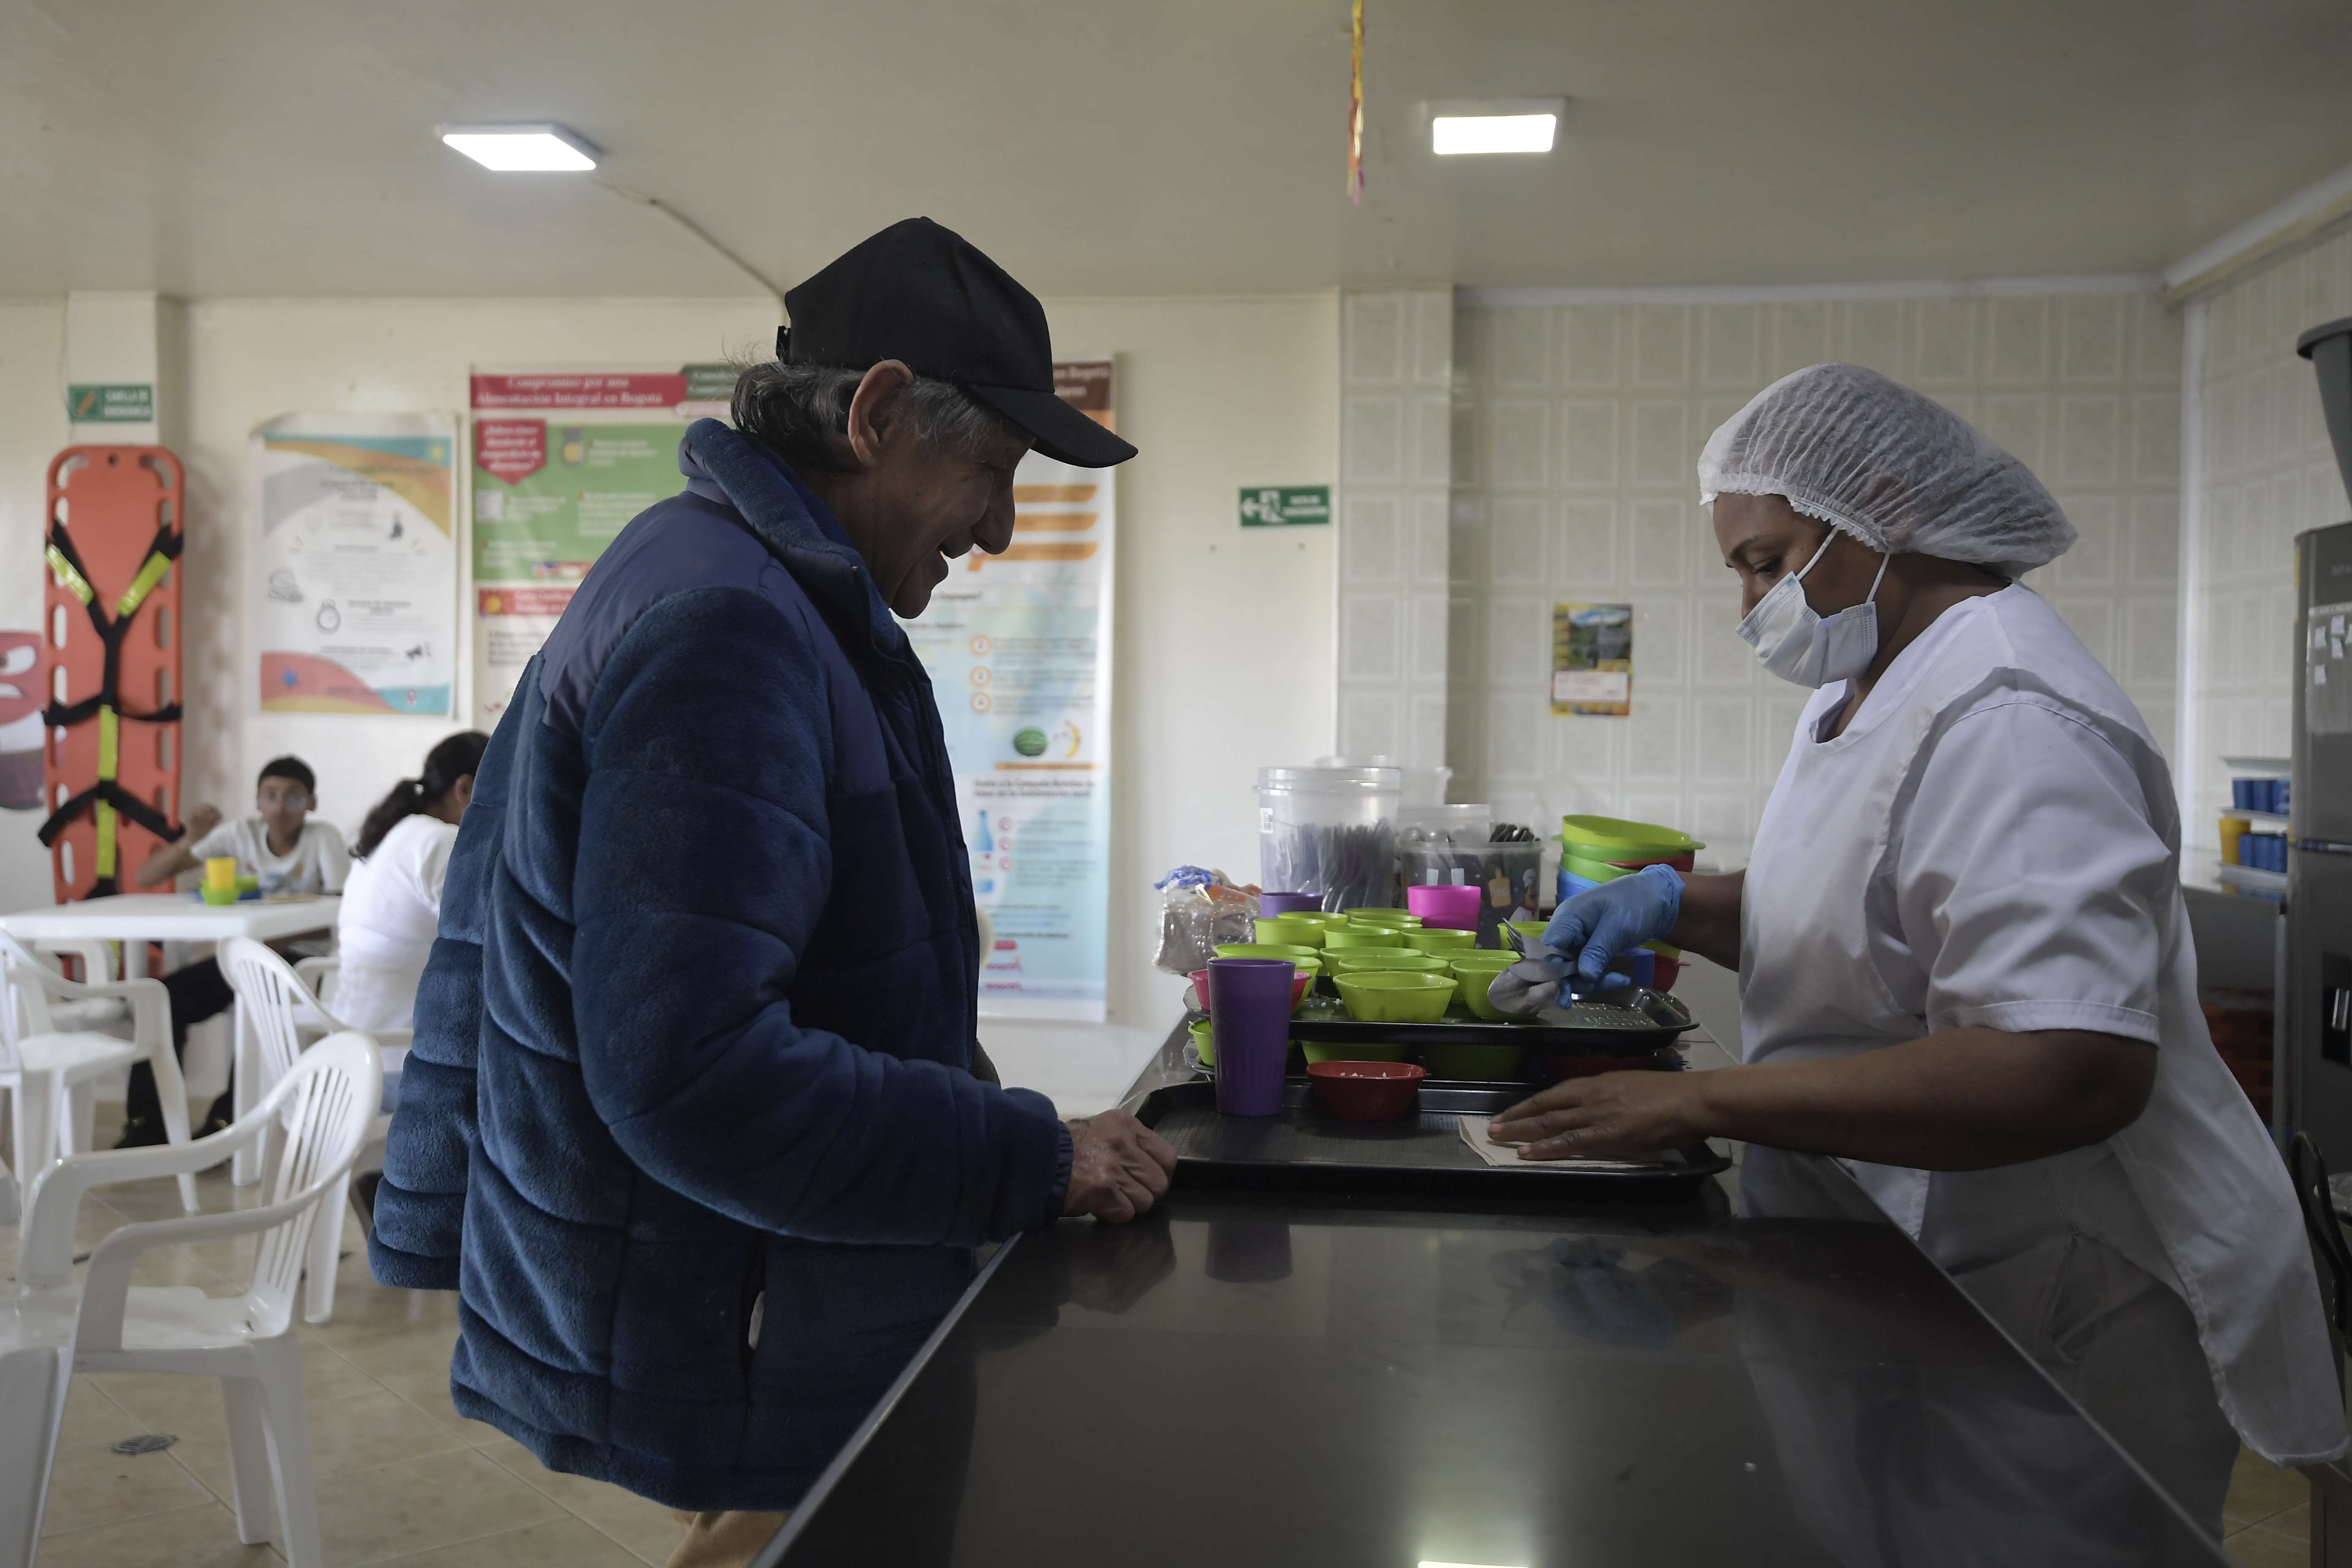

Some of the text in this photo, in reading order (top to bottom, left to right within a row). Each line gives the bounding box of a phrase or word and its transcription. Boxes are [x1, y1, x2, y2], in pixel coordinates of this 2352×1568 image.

[507, 377, 580, 390] Compromiso
[584, 378, 603, 390] por
[555, 393, 602, 406] Integral
[605, 396, 618, 404] en
[621, 393, 663, 406] Bogotá
